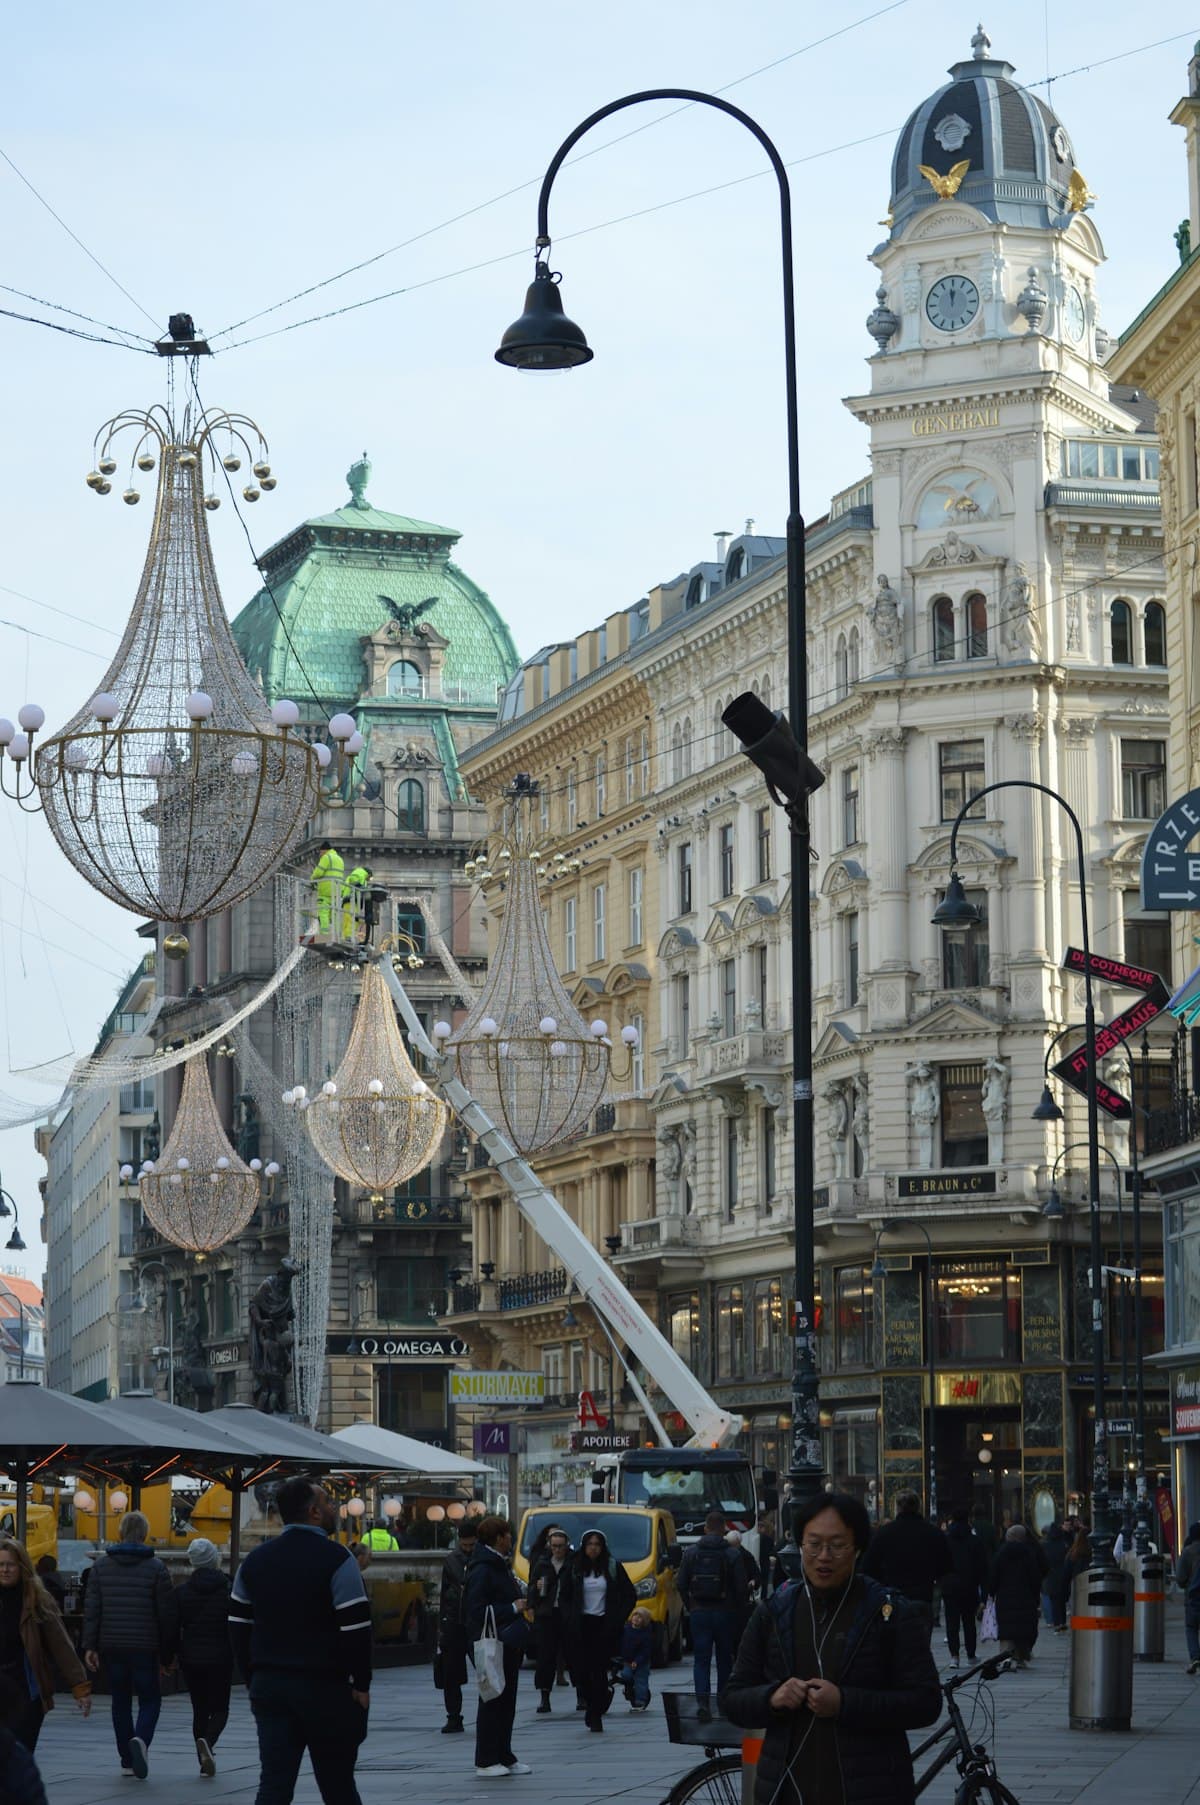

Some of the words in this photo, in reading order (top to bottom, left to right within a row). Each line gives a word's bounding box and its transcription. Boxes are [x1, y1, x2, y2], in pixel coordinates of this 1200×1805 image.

[911, 408, 1000, 436] GENERALI
[1071, 951, 1155, 984] DICOTHEQUE
[909, 1181, 918, 1192] E.
[922, 1178, 959, 1192] BRAUN
[1029, 1315, 1054, 1325] BERLIN
[384, 1341, 444, 1355] OMEGA
[216, 1348, 233, 1364] OMEGA
[458, 1376, 539, 1396] STURMAYR
[583, 1436, 630, 1448] APOTHEKE
